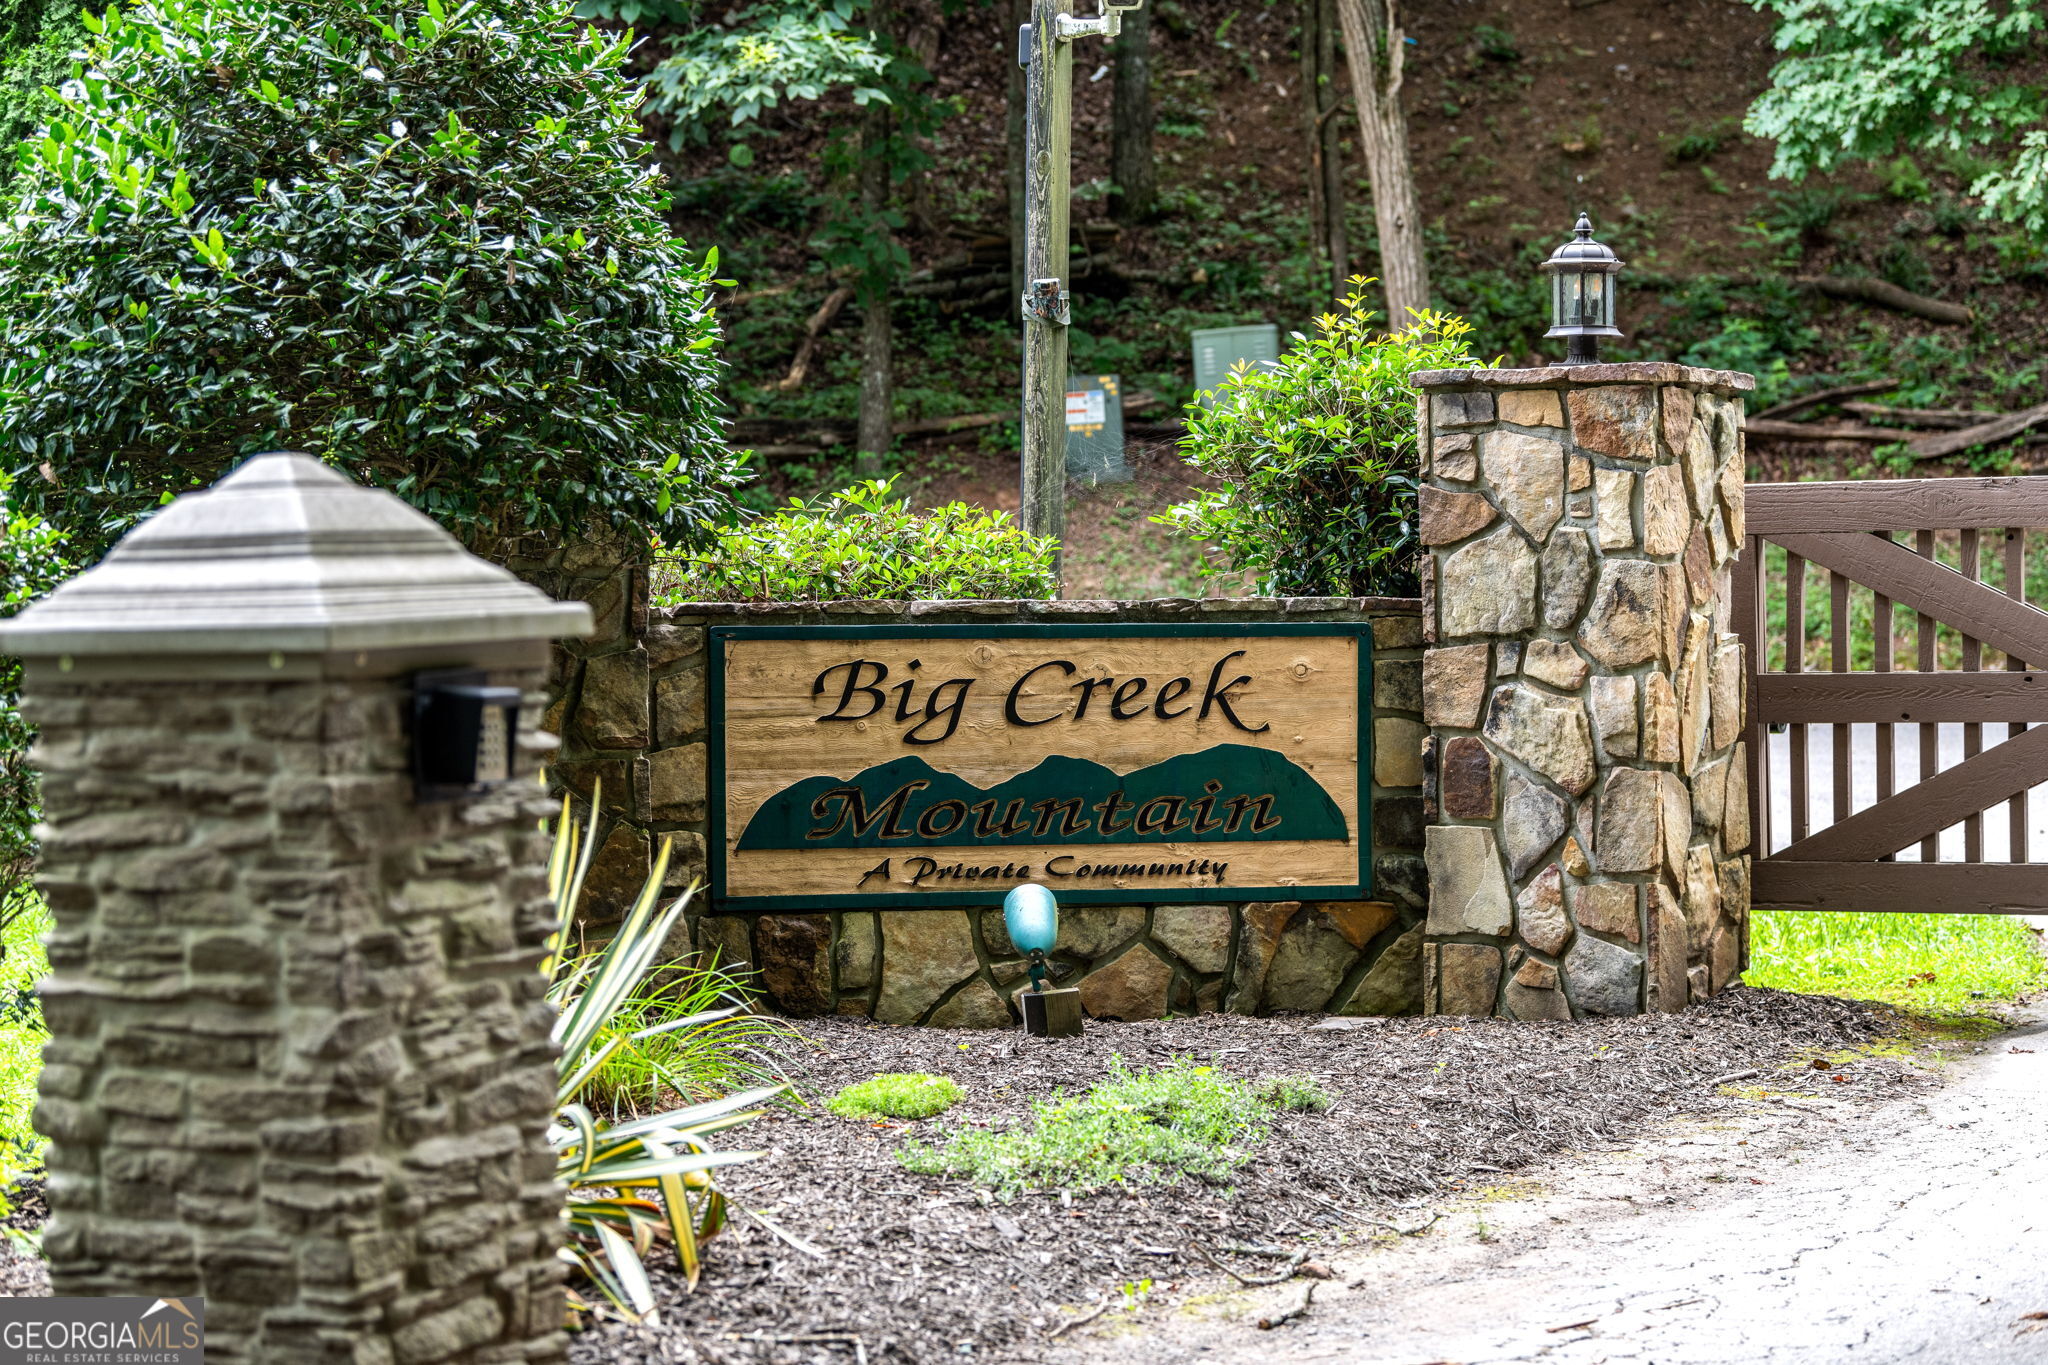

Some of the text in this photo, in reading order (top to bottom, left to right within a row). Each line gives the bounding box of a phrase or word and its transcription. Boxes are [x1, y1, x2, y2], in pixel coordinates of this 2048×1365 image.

[812, 650, 1270, 745] Big Creek
[805, 778, 1282, 840] Mountain
[857, 855, 1229, 888] A Private Community
